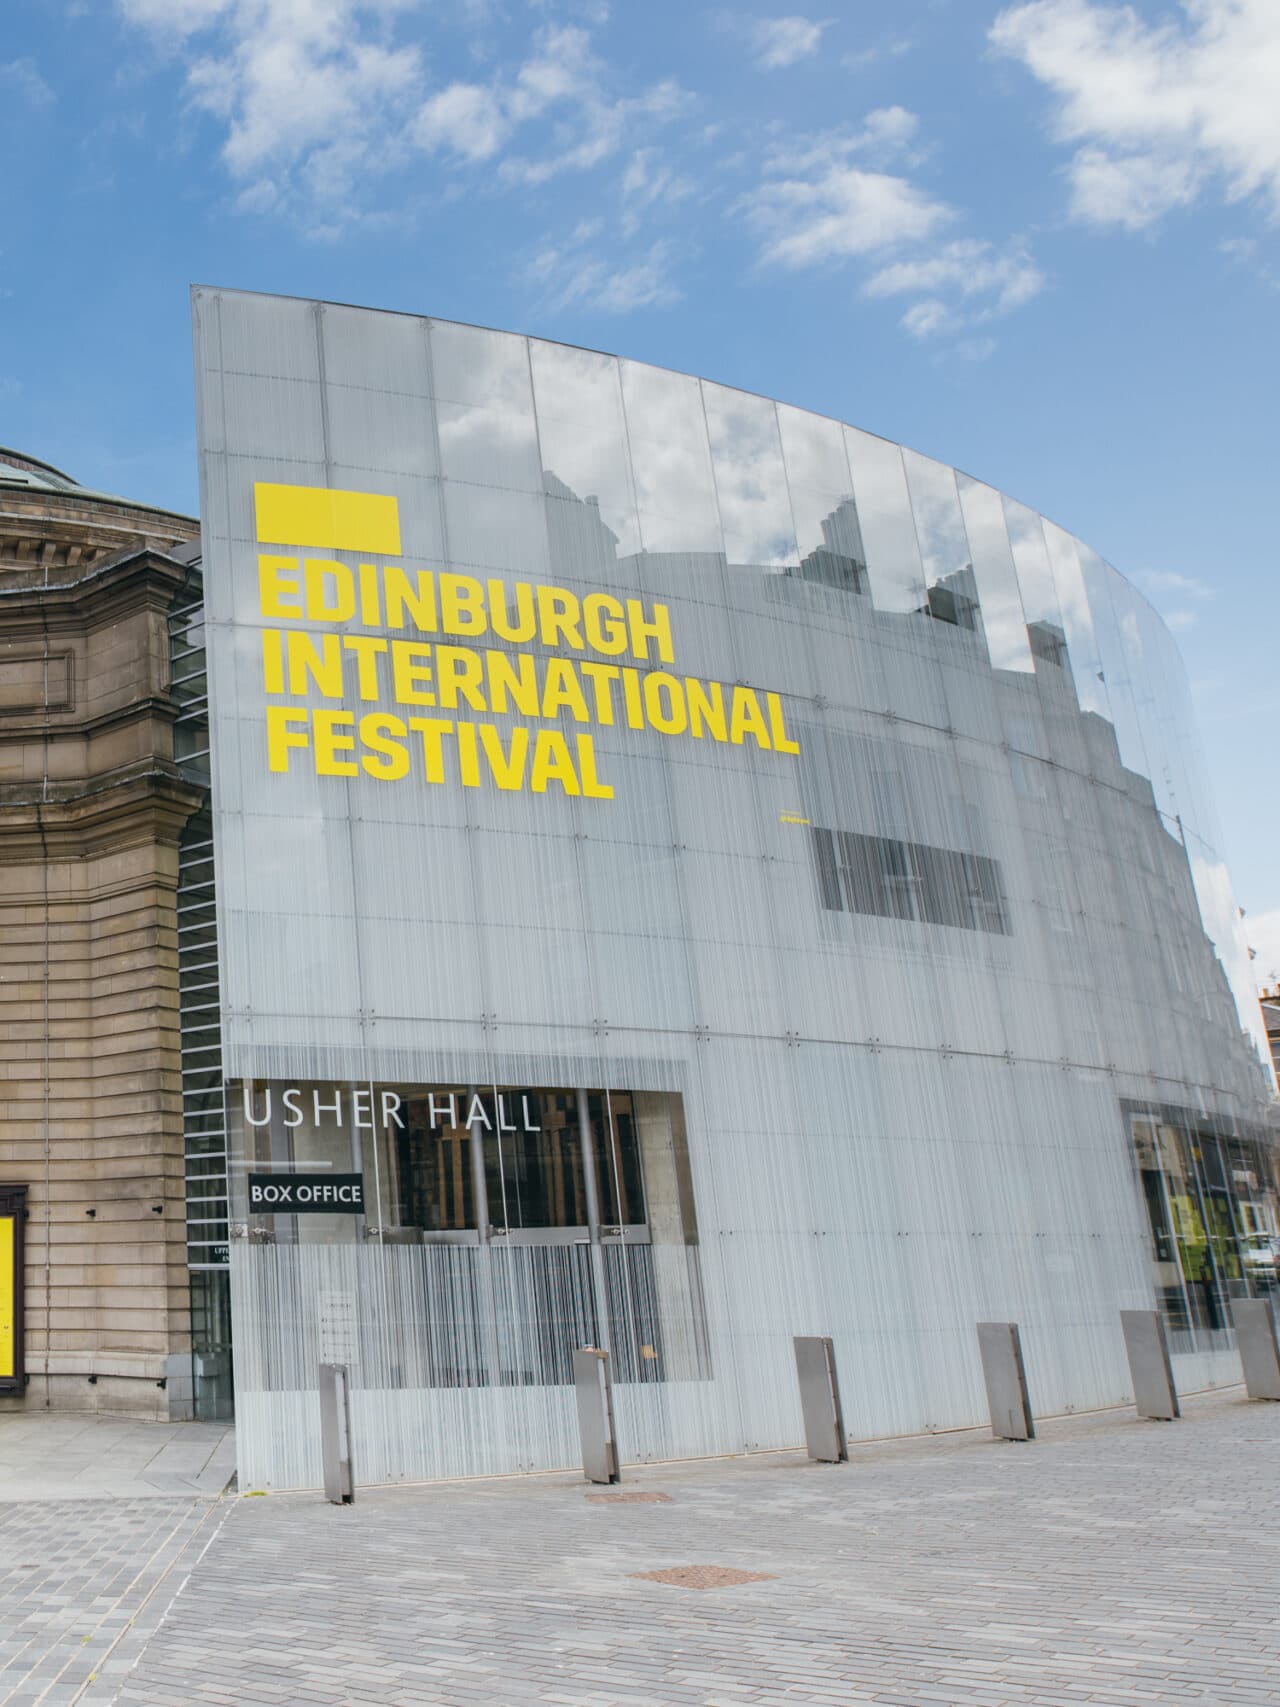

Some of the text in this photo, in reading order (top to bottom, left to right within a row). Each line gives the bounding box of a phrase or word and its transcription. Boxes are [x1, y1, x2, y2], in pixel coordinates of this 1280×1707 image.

[257, 554, 675, 663] EDINBURGH
[262, 629, 800, 755] INTERNATIONAL
[266, 705, 614, 799] FESTIVAL
[243, 1088, 541, 1132] USHER HALL
[251, 1185, 362, 1203] BOX OFFICE
